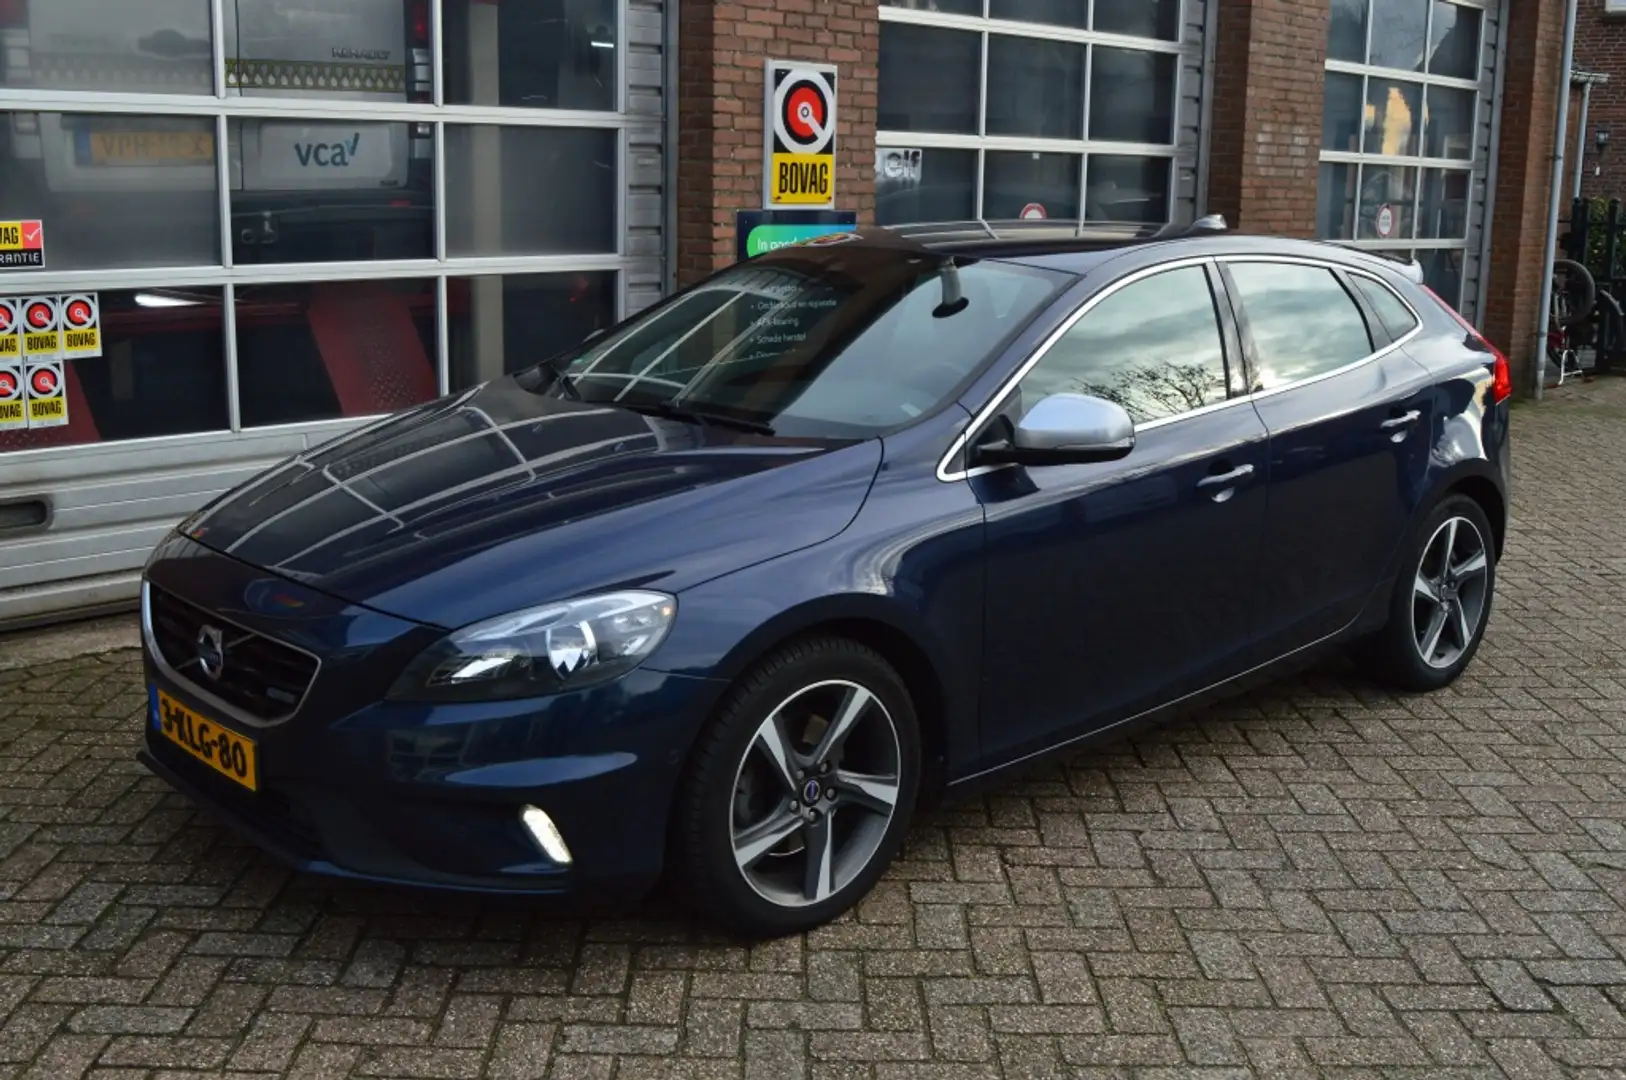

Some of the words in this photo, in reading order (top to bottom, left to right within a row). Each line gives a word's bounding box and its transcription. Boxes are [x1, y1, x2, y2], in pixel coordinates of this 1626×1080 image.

[778, 161, 829, 194] BOVAG
[757, 237, 768, 251] In
[27, 335, 57, 351] BOVAG
[66, 332, 96, 348] BOVAG
[32, 400, 62, 417] BOVAG
